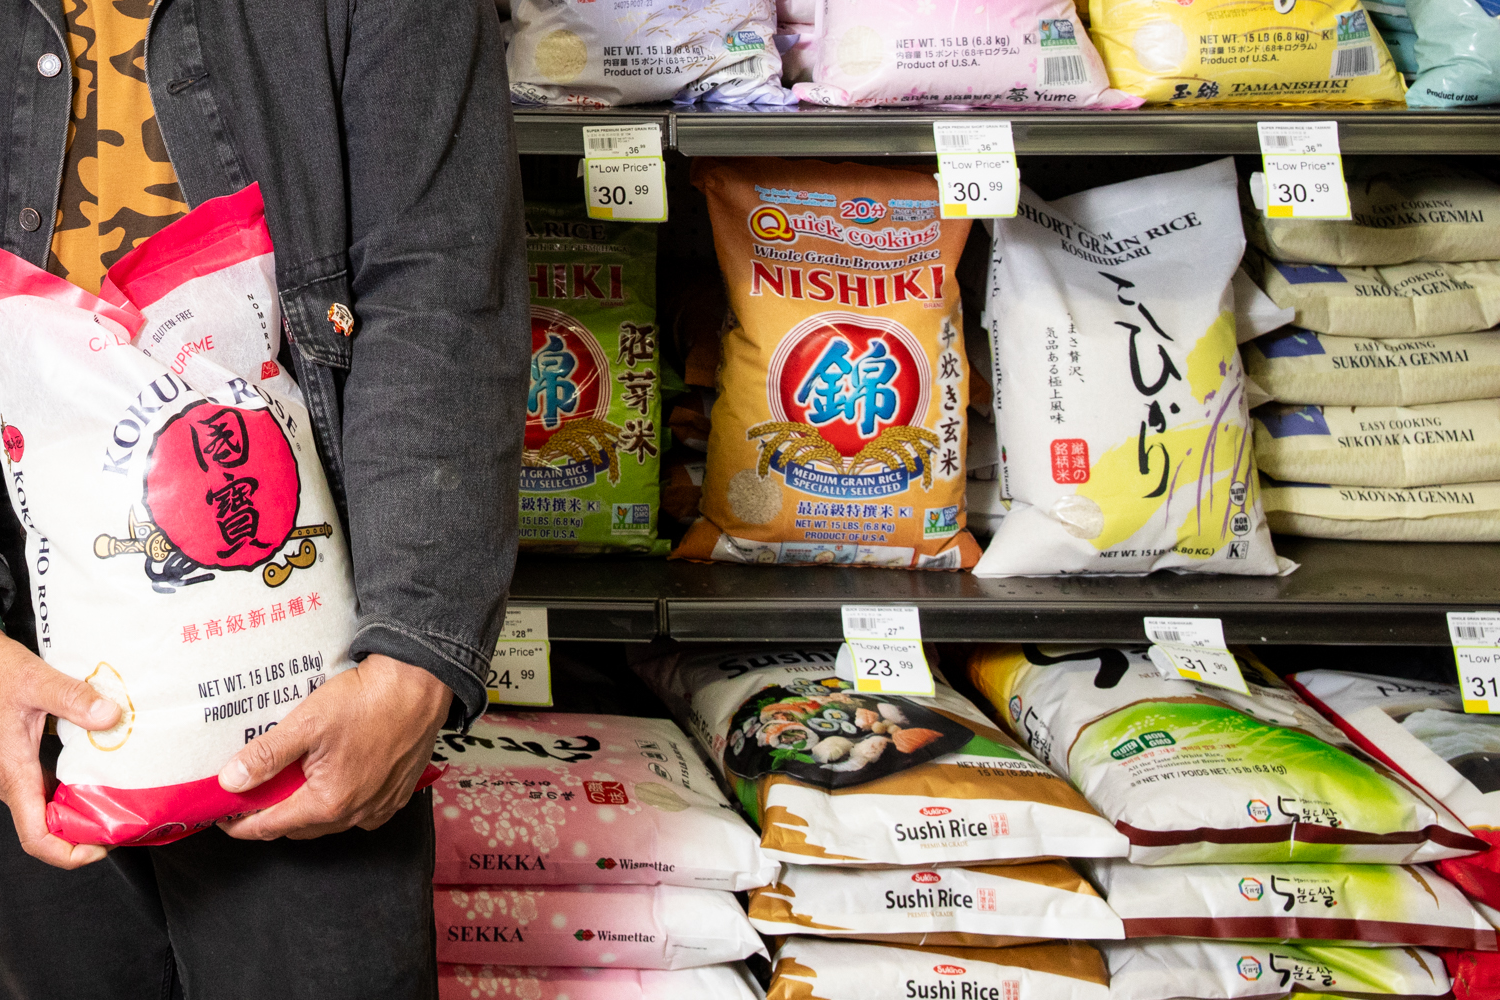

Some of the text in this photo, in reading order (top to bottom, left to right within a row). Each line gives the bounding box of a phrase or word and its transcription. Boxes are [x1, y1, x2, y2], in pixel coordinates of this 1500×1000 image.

[896, 58, 980, 71] Product of U.S.A.
[750, 205, 940, 251] Quick cooking
[1017, 202, 1203, 257] SHORT GRAIN RICE
[753, 244, 941, 270] Whole Grain Brown Rice
[750, 260, 946, 308] NISHIKI
[151, 308, 195, 345] GLUTEN-FREE
[1332, 348, 1470, 370] SUKOYAKA GENMAI
[1354, 340, 1436, 353] EASY COOKING
[792, 467, 903, 488] MEDIUM GRAIN RICE
[792, 478, 901, 497] SPECIALLY SELECTED
[198, 651, 324, 699] NET WT. 15 LBS (6.8kg)
[204, 686, 303, 723] PRODUCT OF U.S.A.
[894, 818, 988, 843] Sushi Rice
[469, 853, 546, 871] SEKKA
